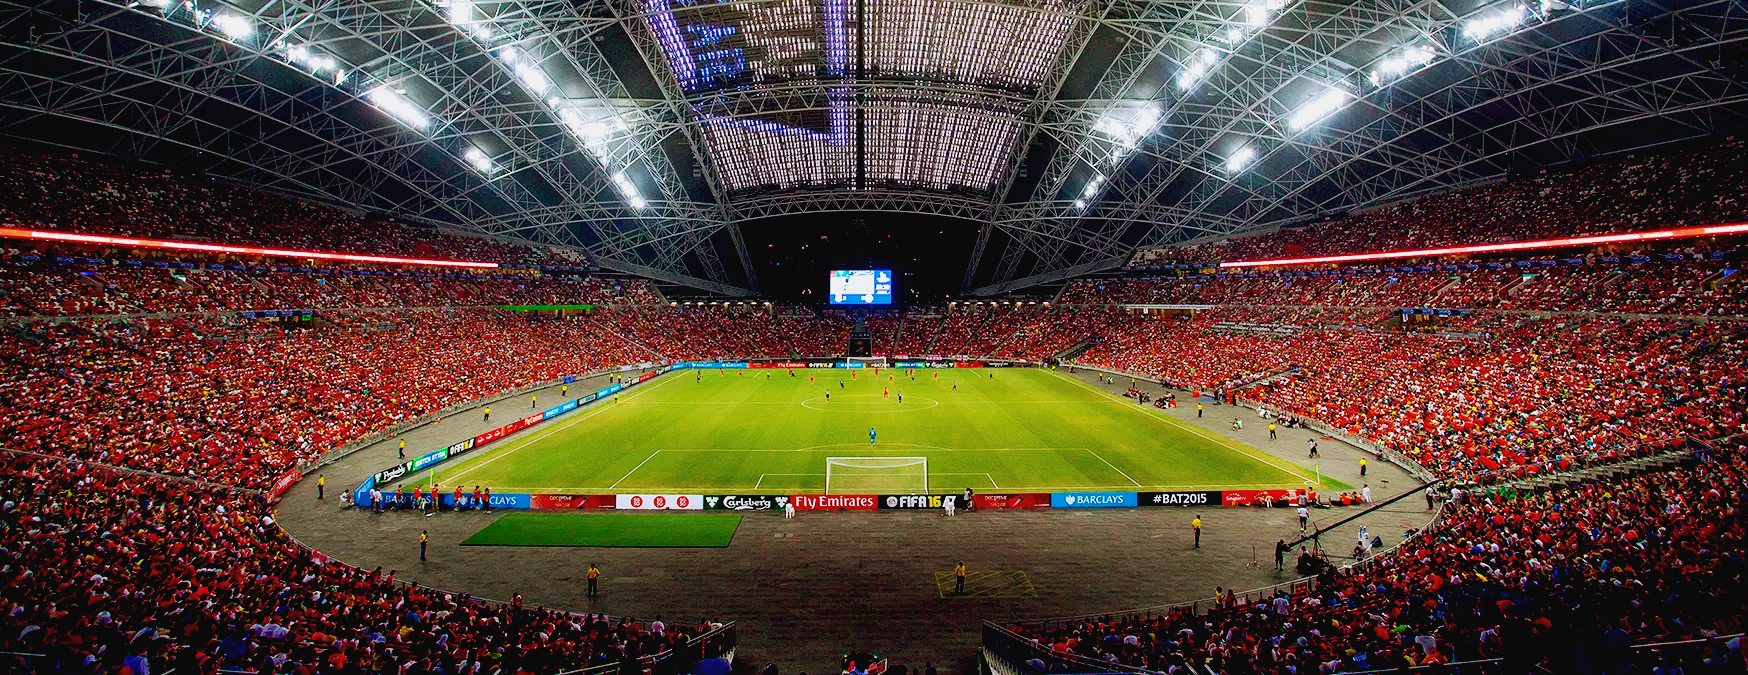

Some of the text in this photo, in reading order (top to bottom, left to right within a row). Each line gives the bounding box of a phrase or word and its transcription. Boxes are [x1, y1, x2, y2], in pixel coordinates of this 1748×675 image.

[723, 496, 771, 510] Carlsberg
[795, 495, 873, 509] Fly Emirates
[900, 496, 941, 508] FIFA 16
[1077, 495, 1124, 504] BARCLAYS
[1153, 493, 1207, 504] #BAT2015
